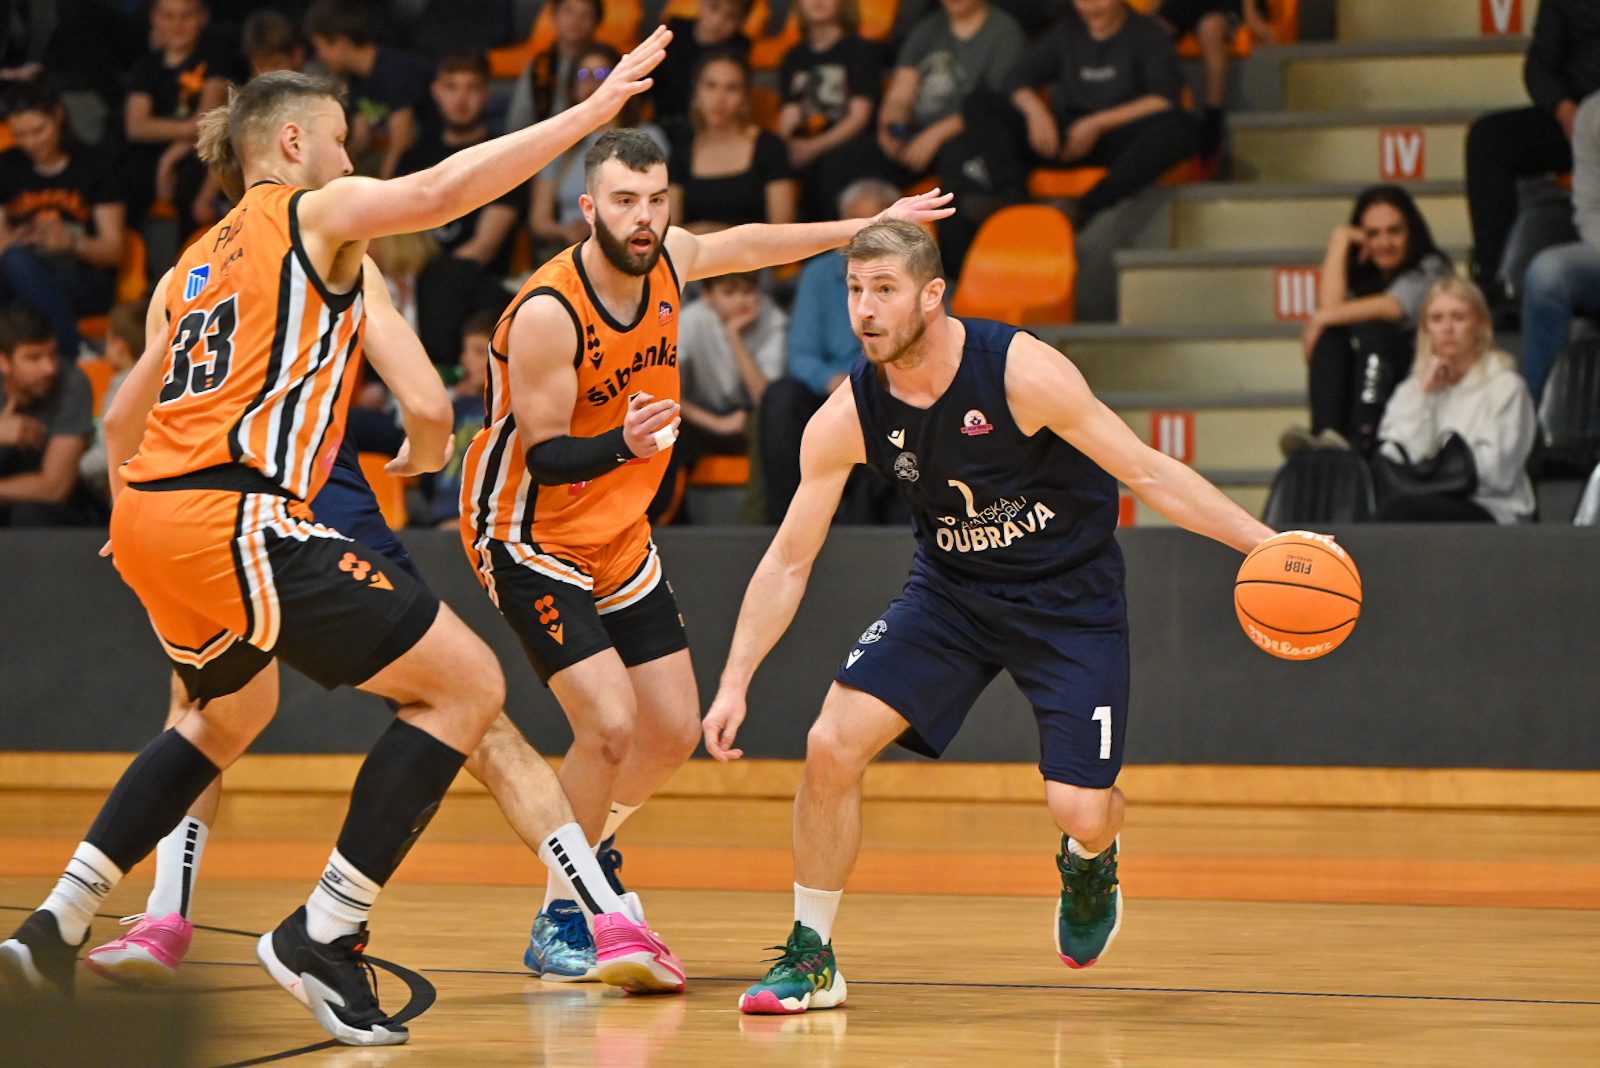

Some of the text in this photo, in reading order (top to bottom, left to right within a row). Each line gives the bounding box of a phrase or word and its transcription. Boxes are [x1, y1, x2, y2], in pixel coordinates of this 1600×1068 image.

[1490, 0, 1513, 32] V
[1384, 134, 1421, 174] IV
[1280, 271, 1314, 314] III
[159, 293, 239, 405] 33
[1161, 414, 1185, 459] II
[936, 501, 1056, 553] DUBRAVA
[1284, 560, 1313, 575] FIBA
[1091, 705, 1112, 760] 1
